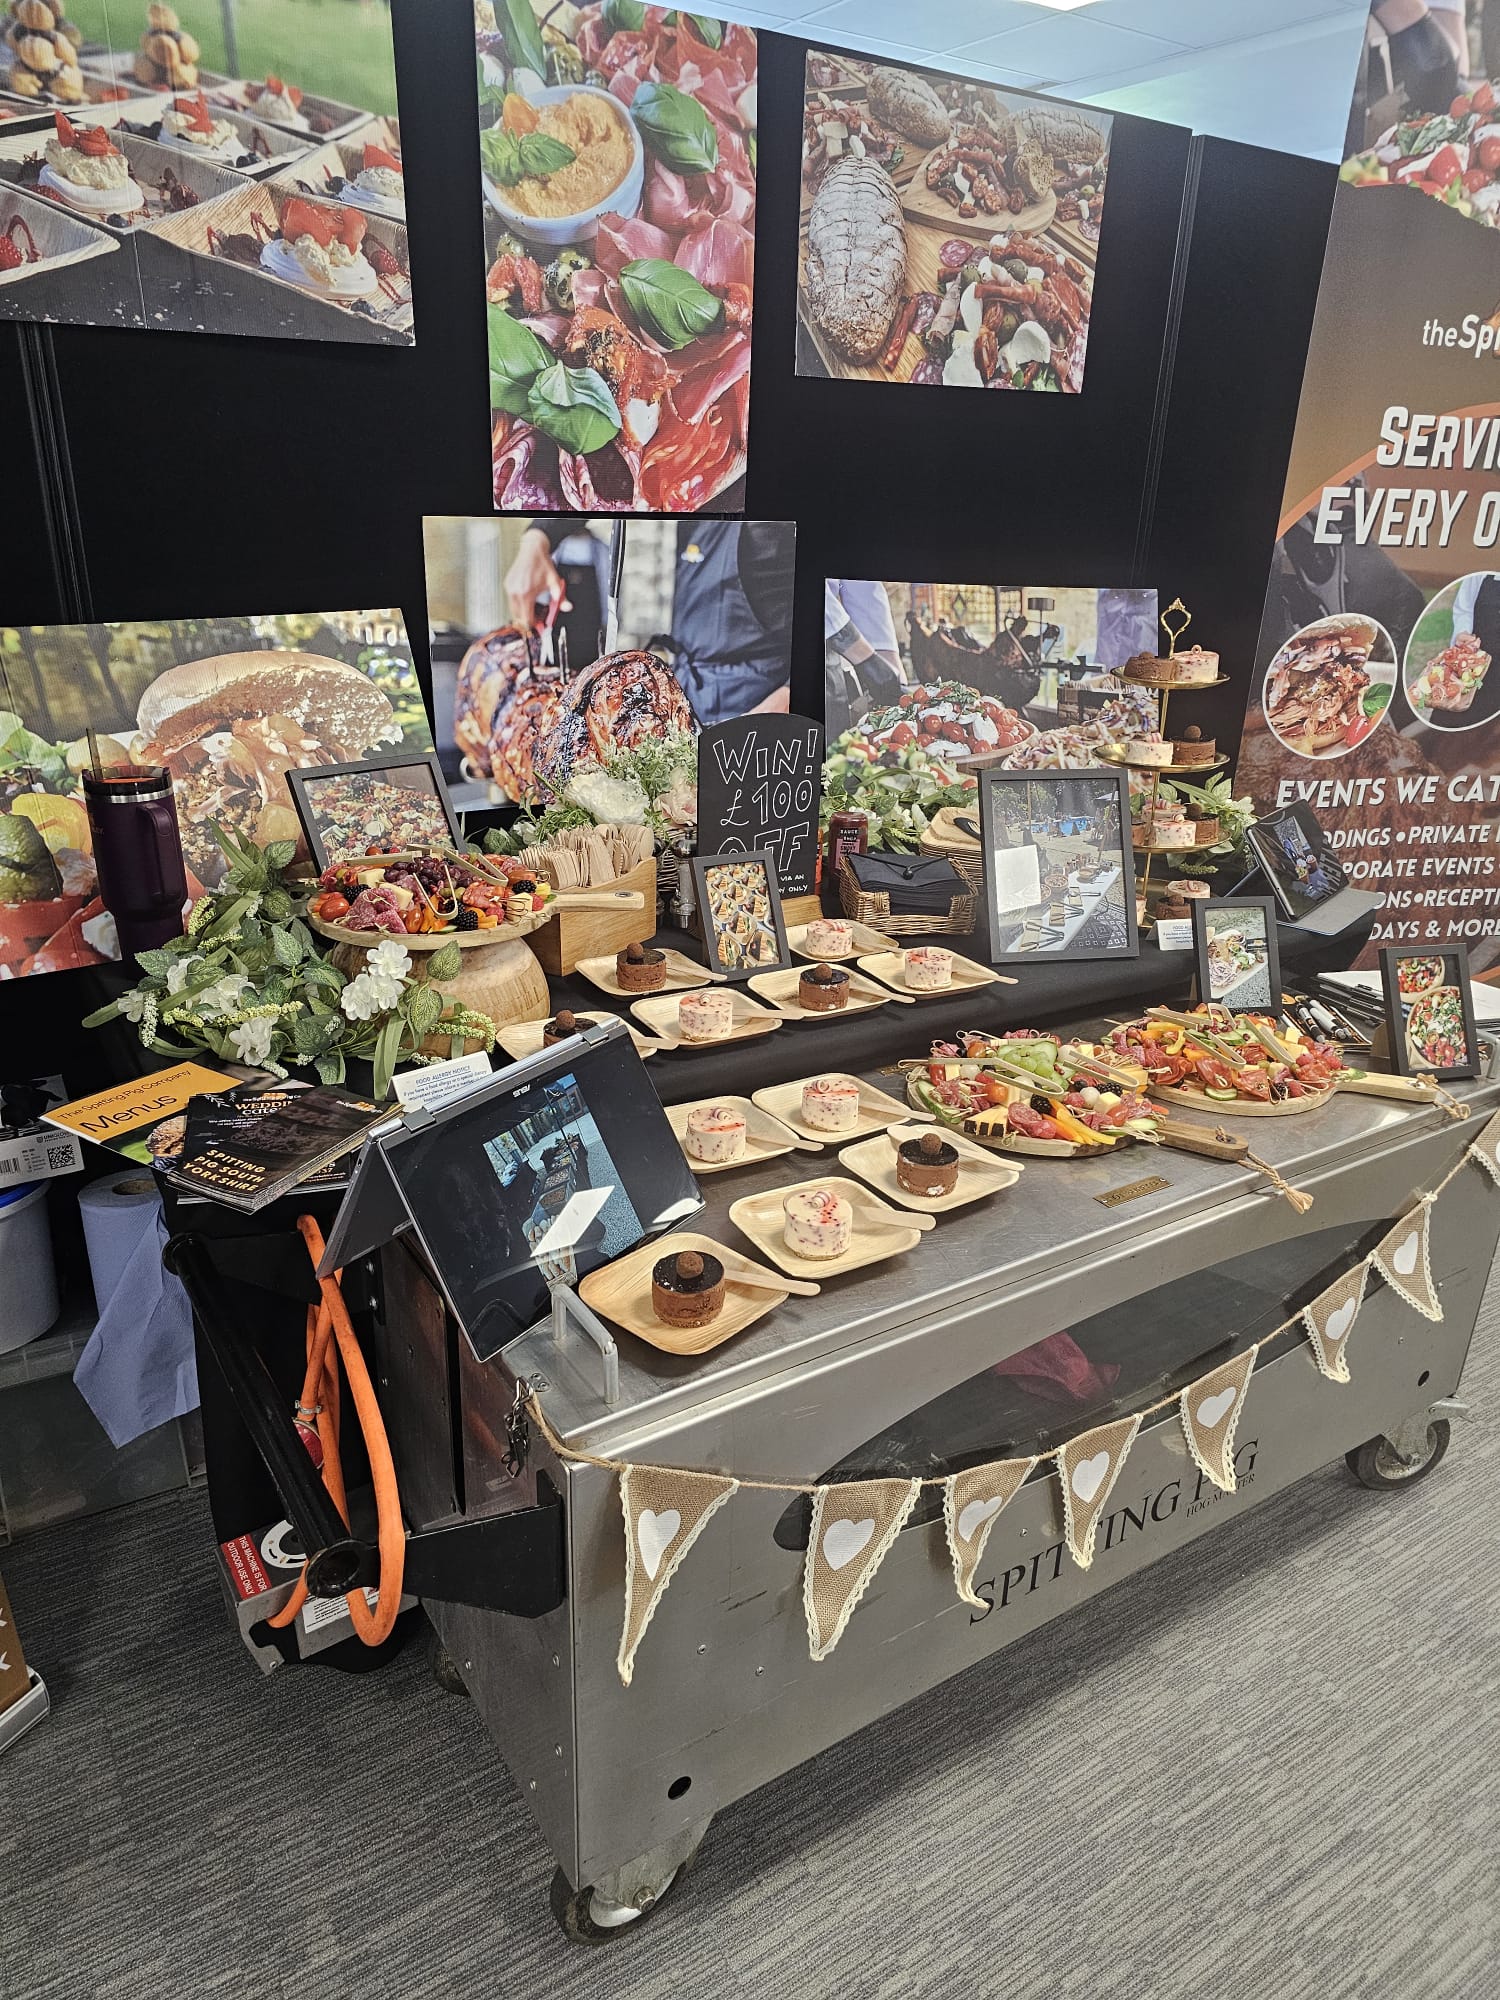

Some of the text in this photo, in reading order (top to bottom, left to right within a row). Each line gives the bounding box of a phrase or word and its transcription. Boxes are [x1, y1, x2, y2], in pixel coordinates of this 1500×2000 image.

[1375, 406, 1500, 469] SERVI
[1313, 486, 1468, 547] EVERY
[712, 728, 818, 785] WIN!
[720, 778, 814, 827] £100
[1276, 777, 1386, 808] EVENTS
[1397, 775, 1440, 805] WE
[1407, 824, 1491, 845] PRIVATE
[1421, 856, 1495, 876] EVENTS
[788, 884, 808, 892] ONLY
[1425, 919, 1442, 938] &
[57, 1070, 191, 1120] The Spitting Pig Company
[79, 1095, 177, 1132] Menus
[242, 1107, 282, 1115] cate
[193, 1156, 265, 1183] PIG SOUTH
[206, 1149, 266, 1173] SPITTING
[183, 1162, 259, 1191] YORKSHIRE
[239, 1535, 250, 1549] THIS
[969, 1438, 1259, 1626] SPITING PG
[227, 1542, 255, 1595] OUTDOOR USE ONLY
[244, 1548, 260, 1573] MACHINE
[256, 1577, 267, 1592] FOR
